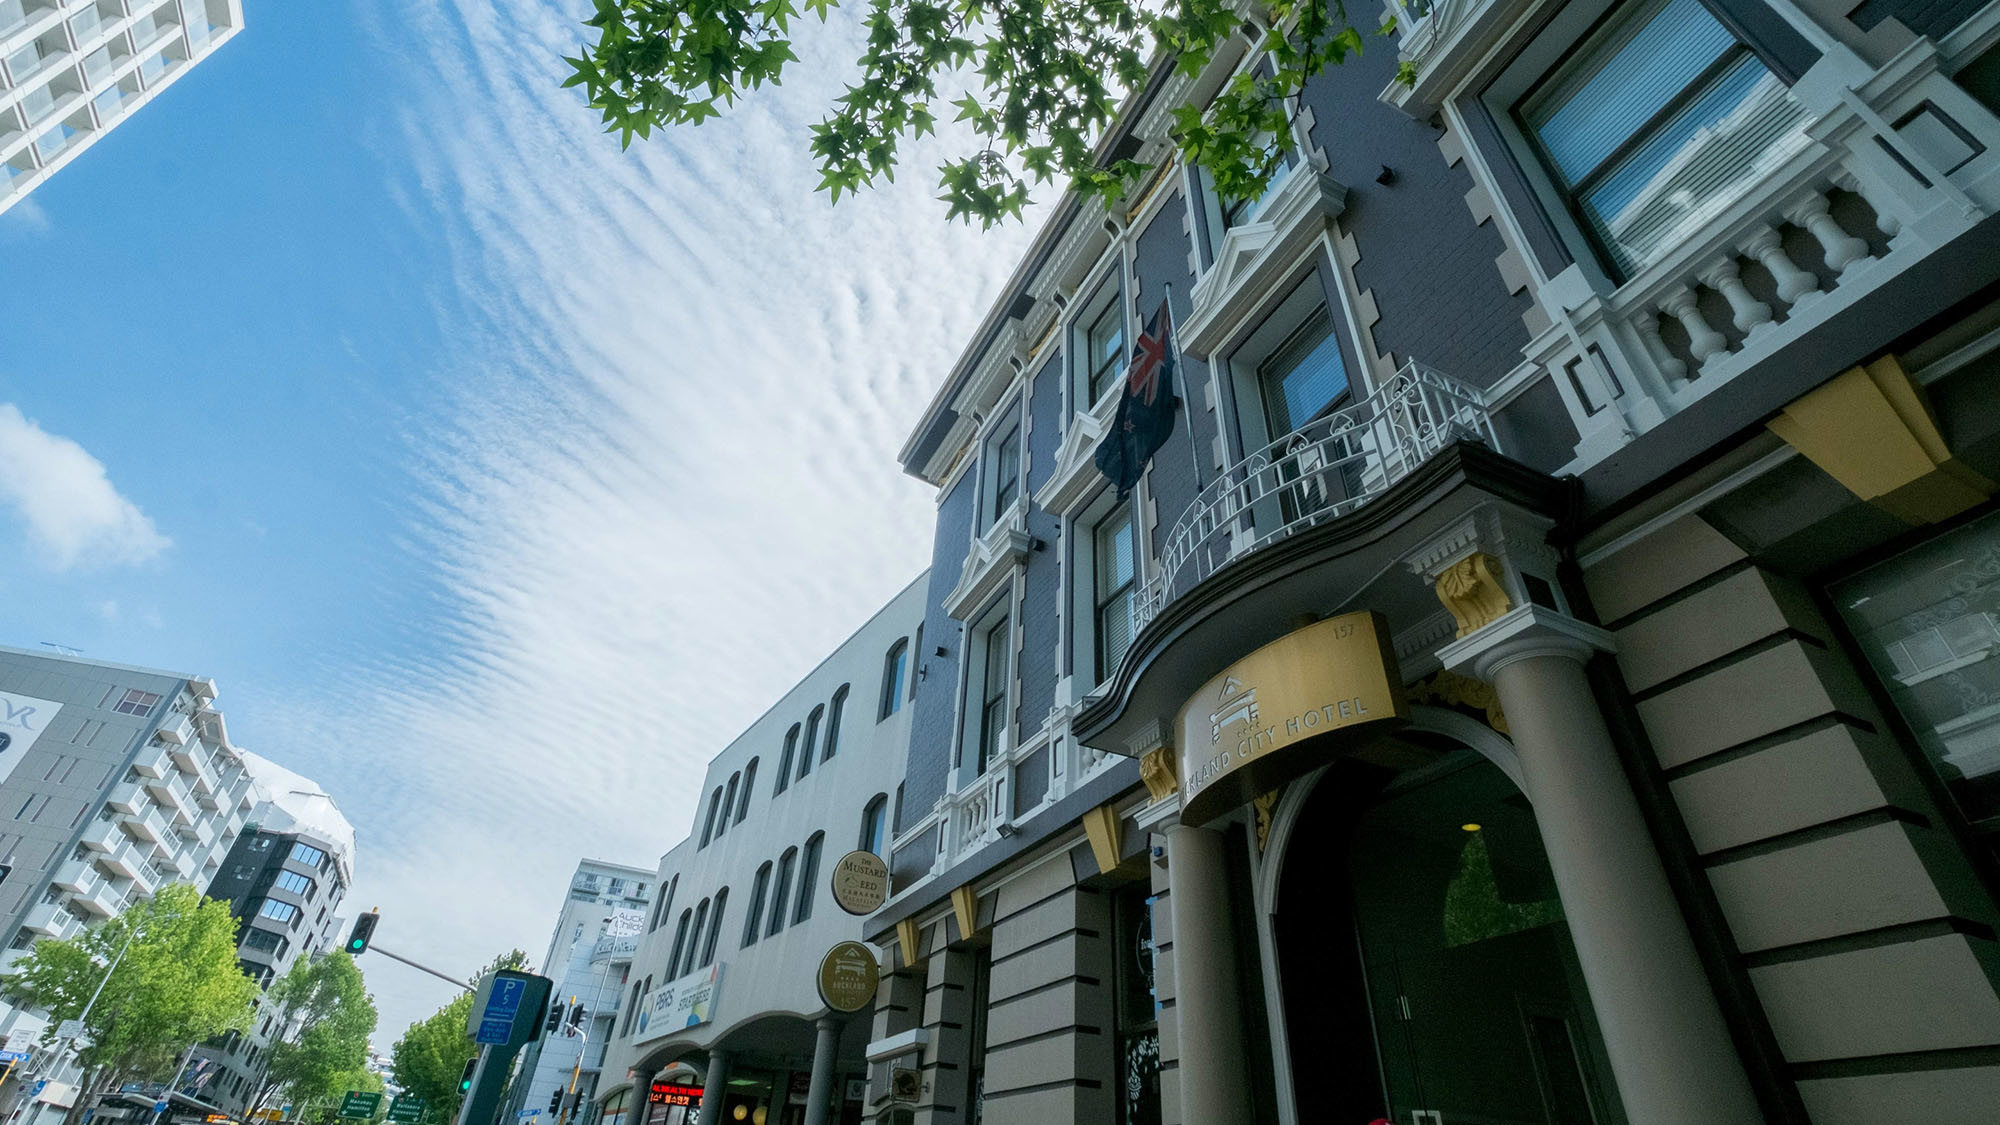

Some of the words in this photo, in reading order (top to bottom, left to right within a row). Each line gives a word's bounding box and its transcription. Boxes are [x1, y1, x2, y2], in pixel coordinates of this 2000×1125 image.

[1333, 624, 1353, 640] 157
[1238, 725, 1276, 758] CITY
[1286, 697, 1368, 736] HOTEL
[843, 859, 886, 878] MUSTARD
[504, 981, 516, 994] P
